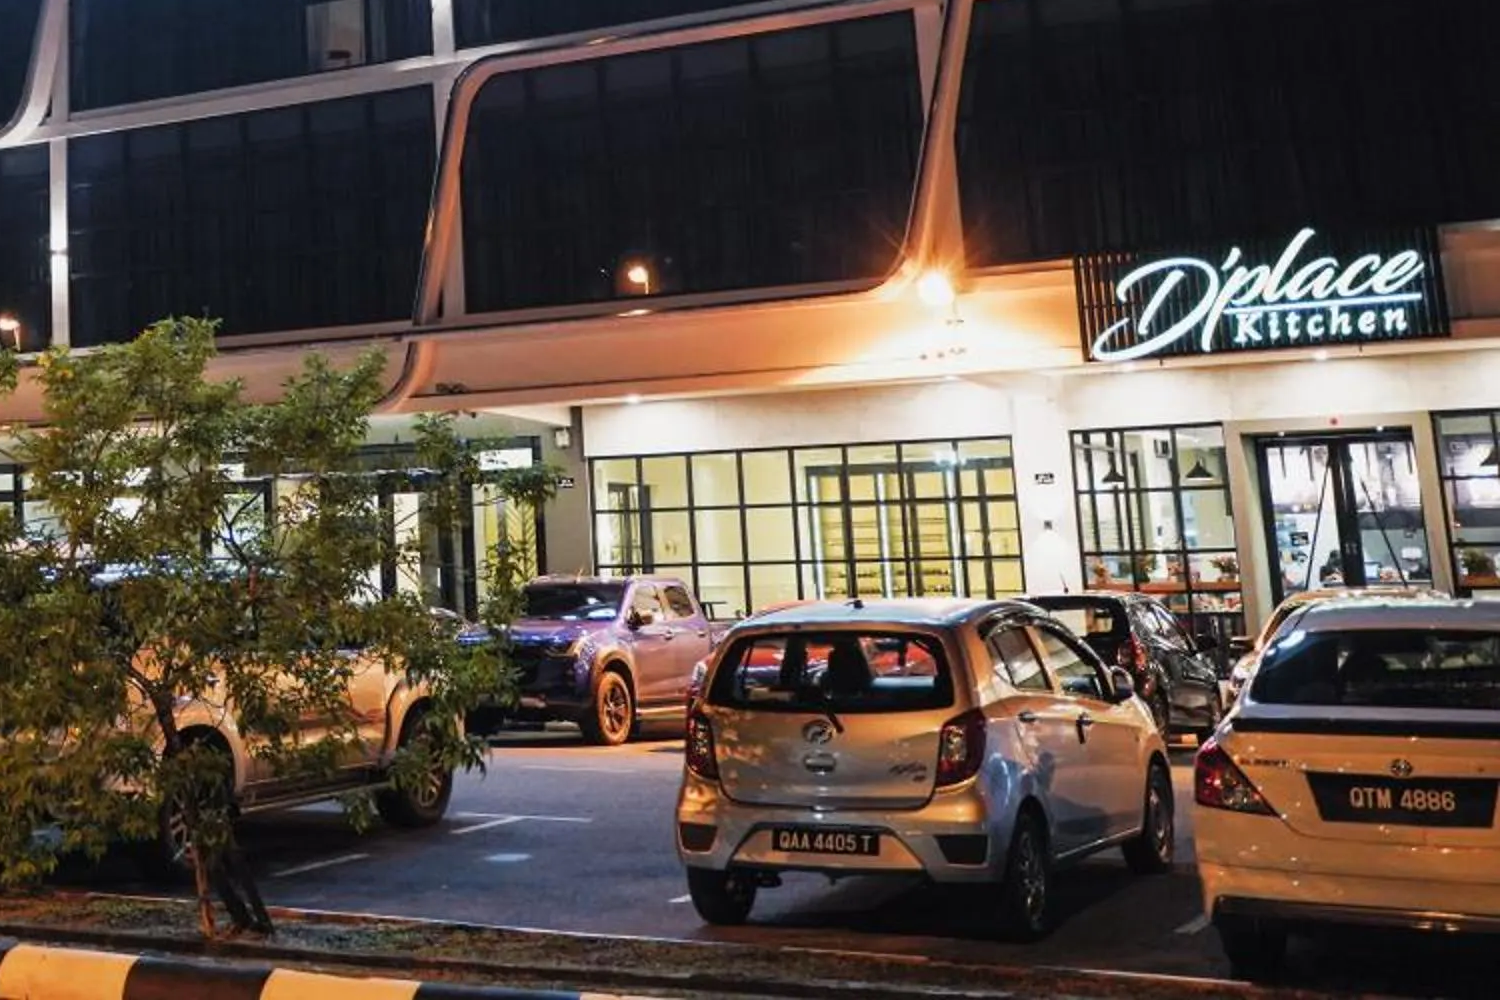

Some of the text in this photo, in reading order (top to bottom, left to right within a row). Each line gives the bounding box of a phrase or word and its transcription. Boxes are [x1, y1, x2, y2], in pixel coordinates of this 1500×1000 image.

[1093, 227, 1425, 362] D'place
[1233, 307, 1408, 344] Kitchen
[1349, 787, 1456, 812] QTM 4886
[780, 831, 873, 852] QAA 4405 T
